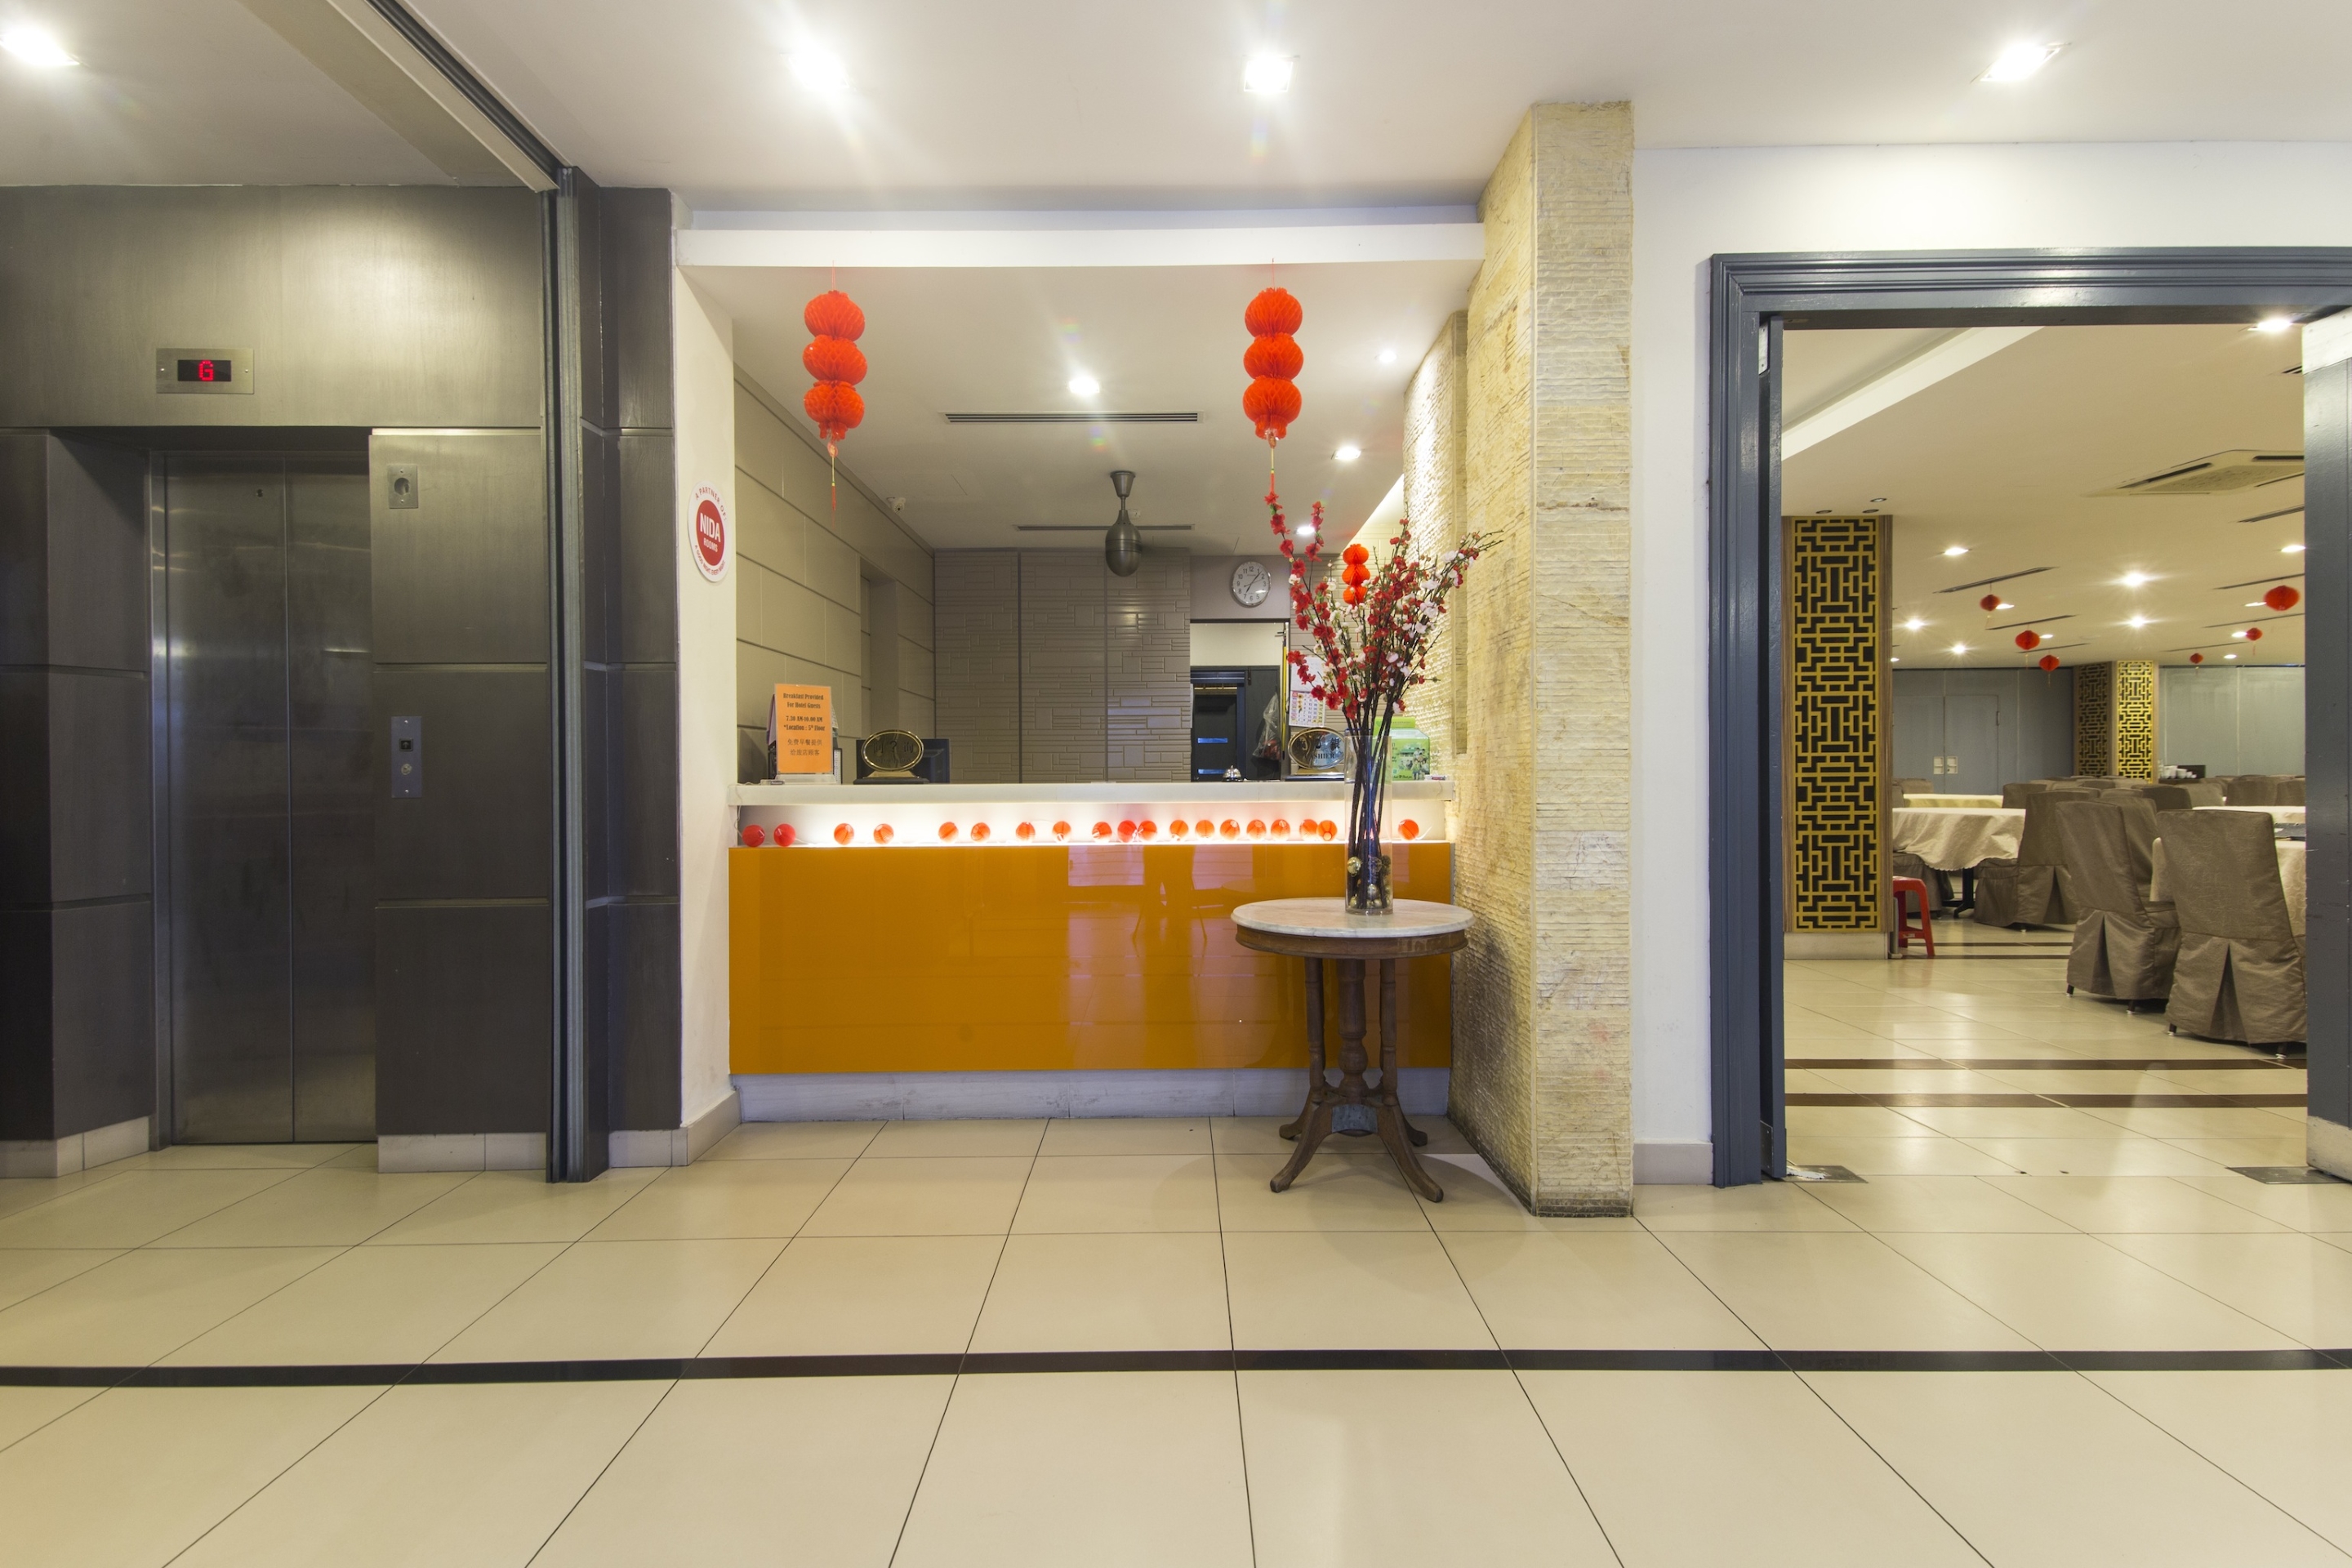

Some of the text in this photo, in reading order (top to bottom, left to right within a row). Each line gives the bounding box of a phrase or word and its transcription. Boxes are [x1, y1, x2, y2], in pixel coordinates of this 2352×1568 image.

[699, 487, 720, 504] PARTNER
[700, 512, 721, 543] NIDA
[703, 537, 718, 553] ROOMS
